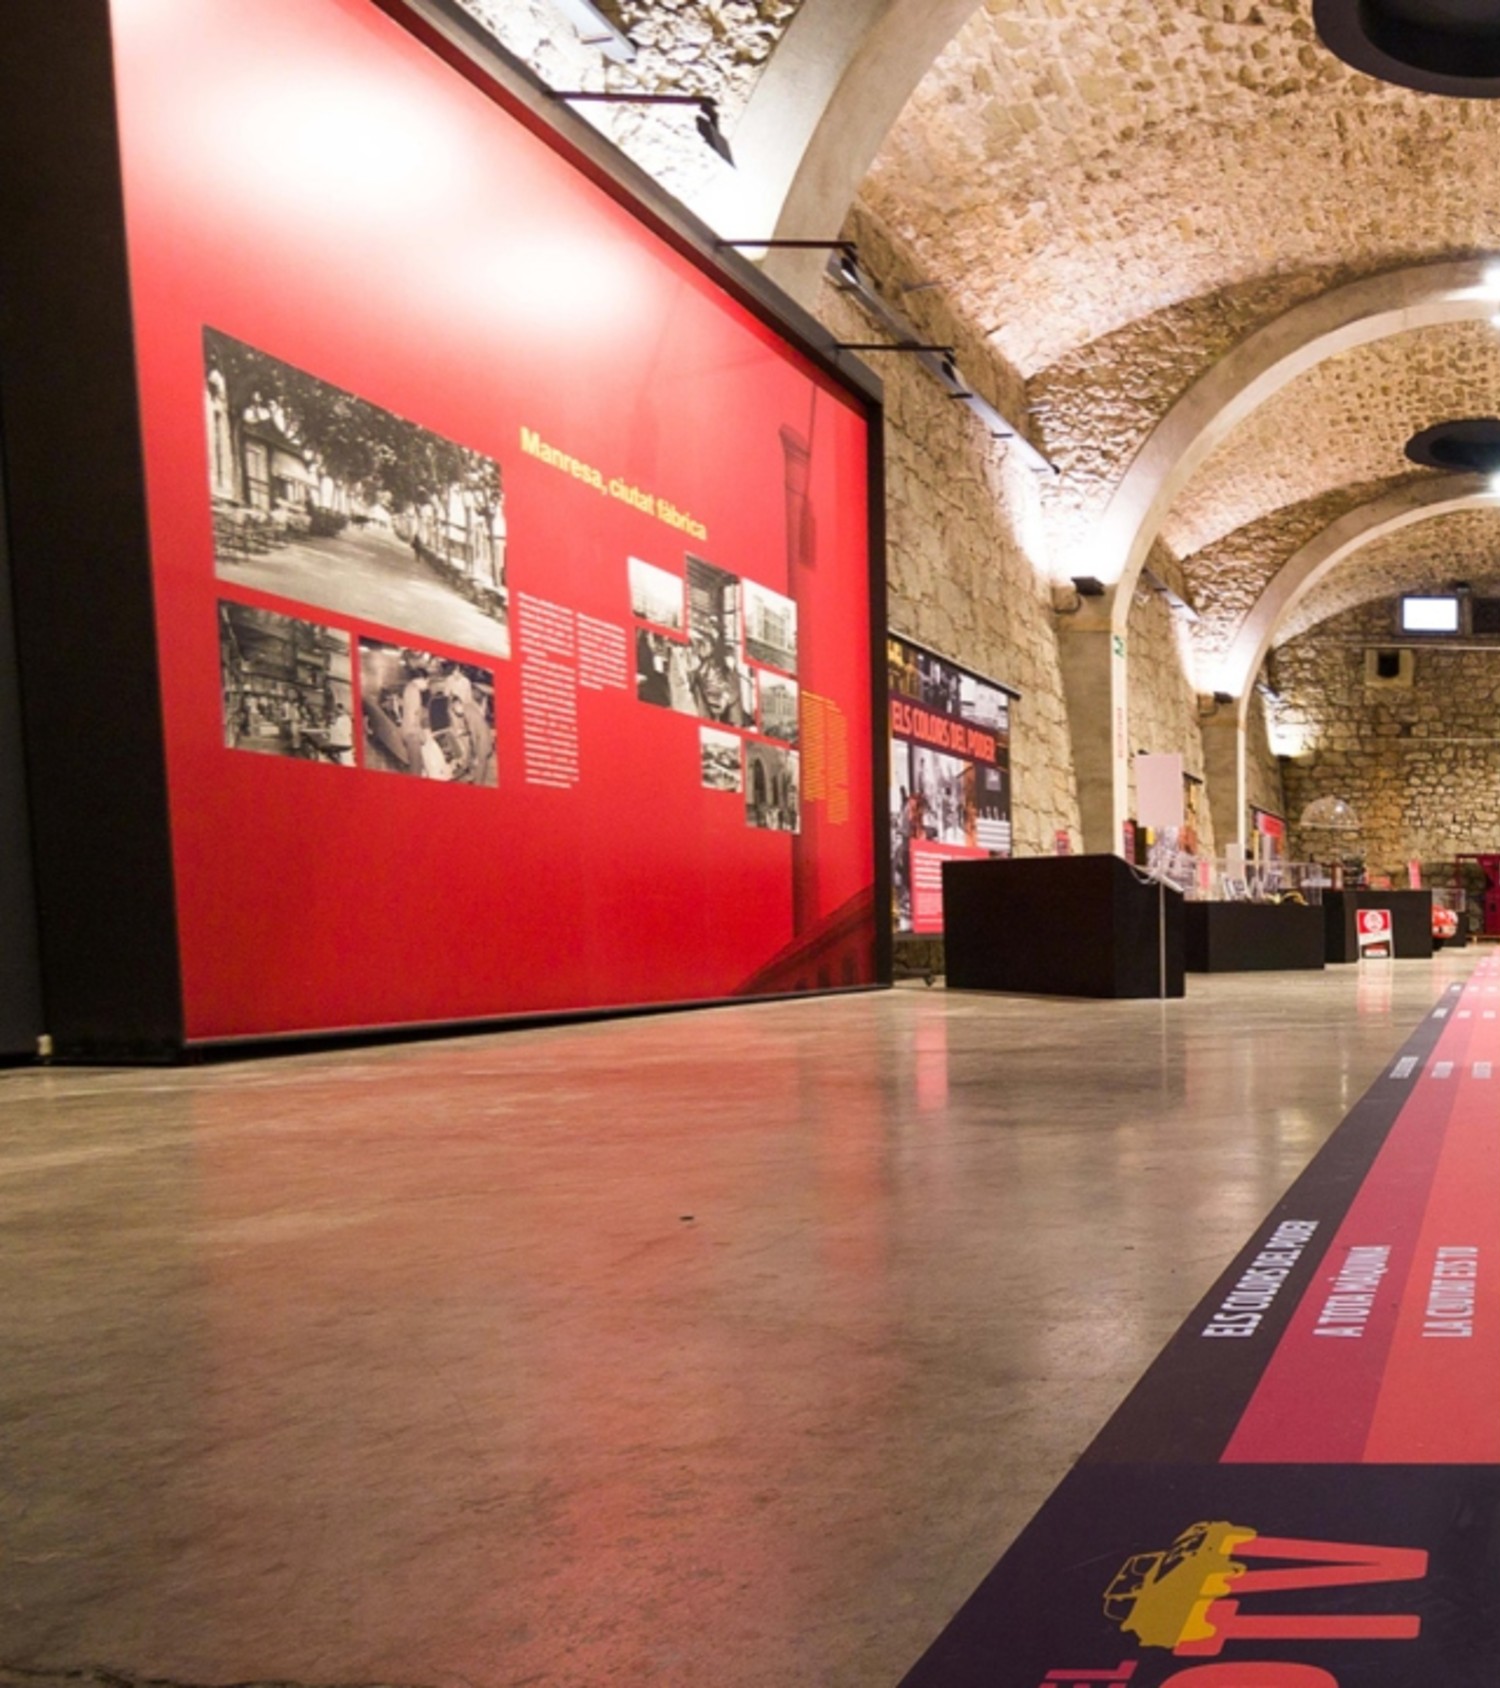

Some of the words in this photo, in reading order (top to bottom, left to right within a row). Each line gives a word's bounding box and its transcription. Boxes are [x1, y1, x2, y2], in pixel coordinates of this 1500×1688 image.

[520, 425, 608, 495] Manresa,
[608, 477, 655, 516] ciutat
[891, 700, 912, 735] ELS
[913, 708, 951, 747] COLORS
[1264, 1220, 1319, 1250] PODER
[1250, 1250, 1302, 1267] DEL
[1437, 1246, 1478, 1259] TU
[1434, 1260, 1477, 1278] ETS
[1220, 1268, 1290, 1311] COLORS
[1425, 1278, 1475, 1317] CIUTAT
[1318, 1294, 1373, 1324] TOTA
[1202, 1312, 1262, 1338] ELS
[1313, 1327, 1363, 1338] A
[1422, 1320, 1473, 1338] LA
